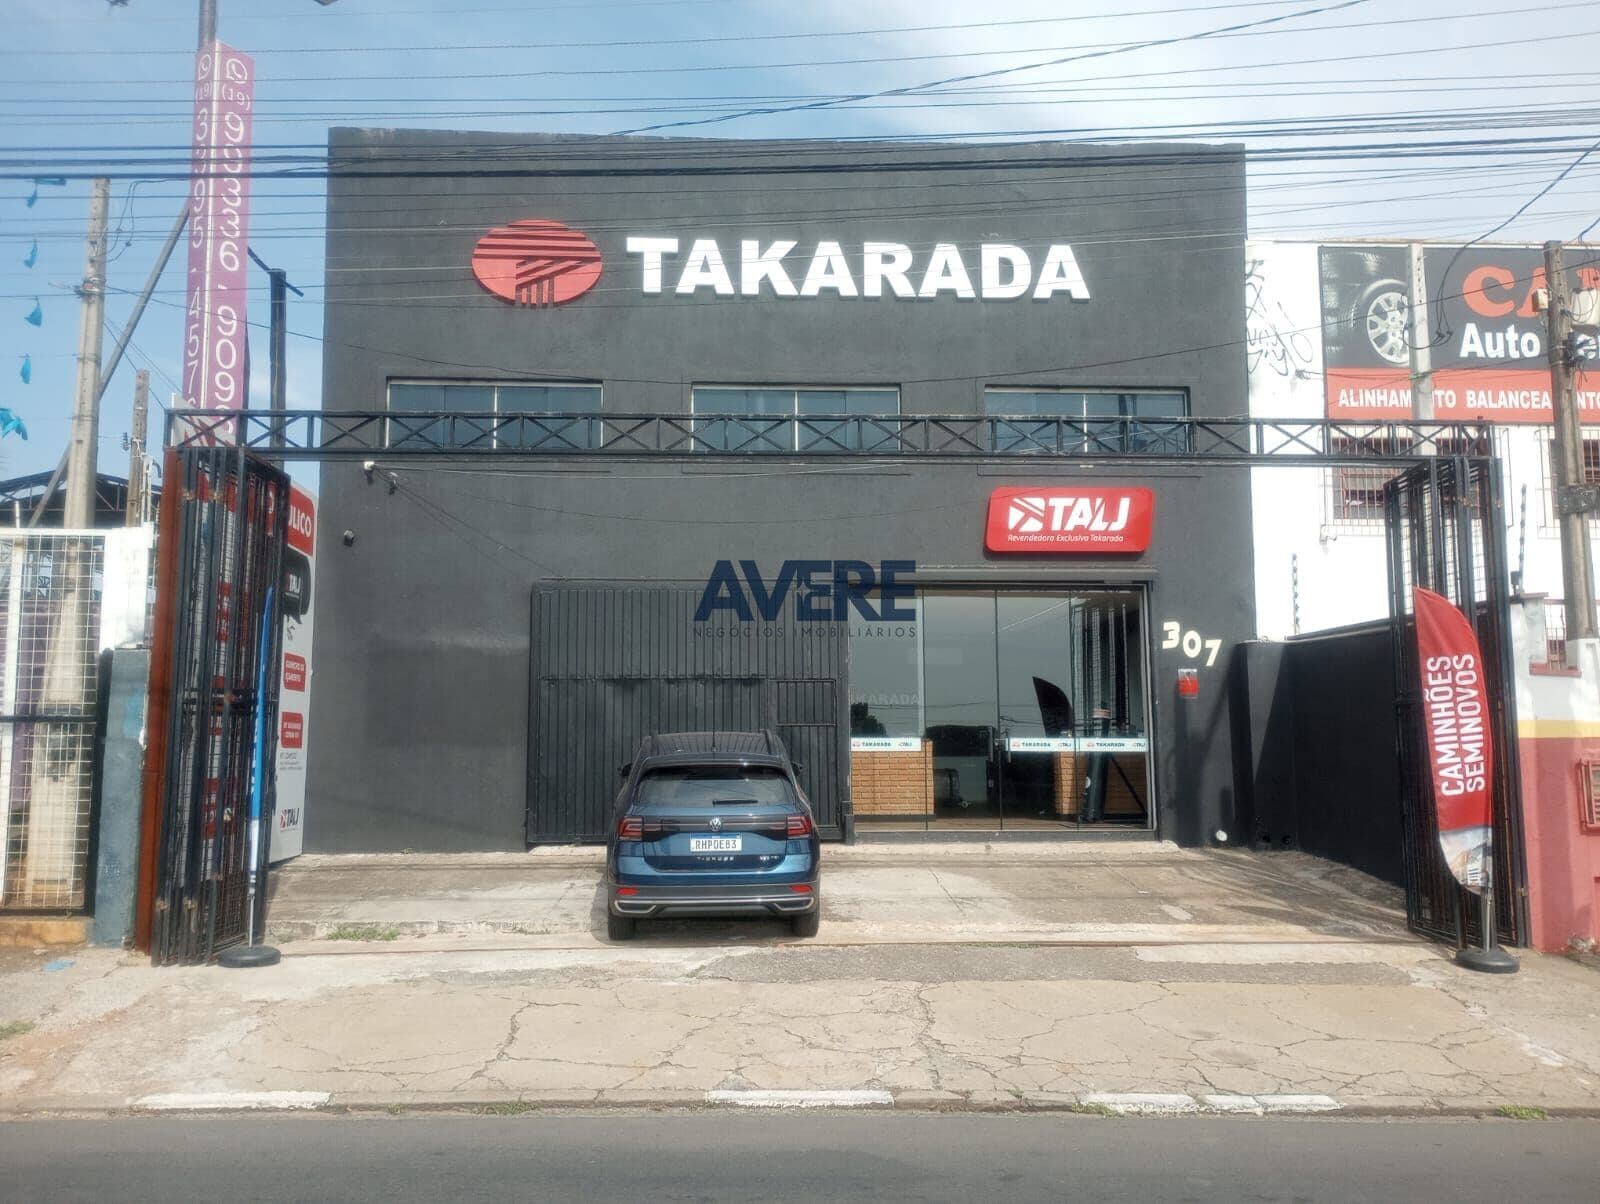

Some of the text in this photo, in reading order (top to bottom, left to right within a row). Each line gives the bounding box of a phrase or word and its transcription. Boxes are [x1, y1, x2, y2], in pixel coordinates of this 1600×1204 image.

[222, 84, 251, 111] (19)
[626, 236, 1091, 300] TAKARADA
[1459, 322, 1541, 359] Auto
[1338, 388, 1457, 409] ALINHAMTO
[1007, 534, 1124, 543] Revendedora Exclusiva Takarada
[1162, 621, 1222, 667] 307
[1425, 655, 1465, 797] CAMINHÕES
[1453, 654, 1486, 793] SEMINOVOS
